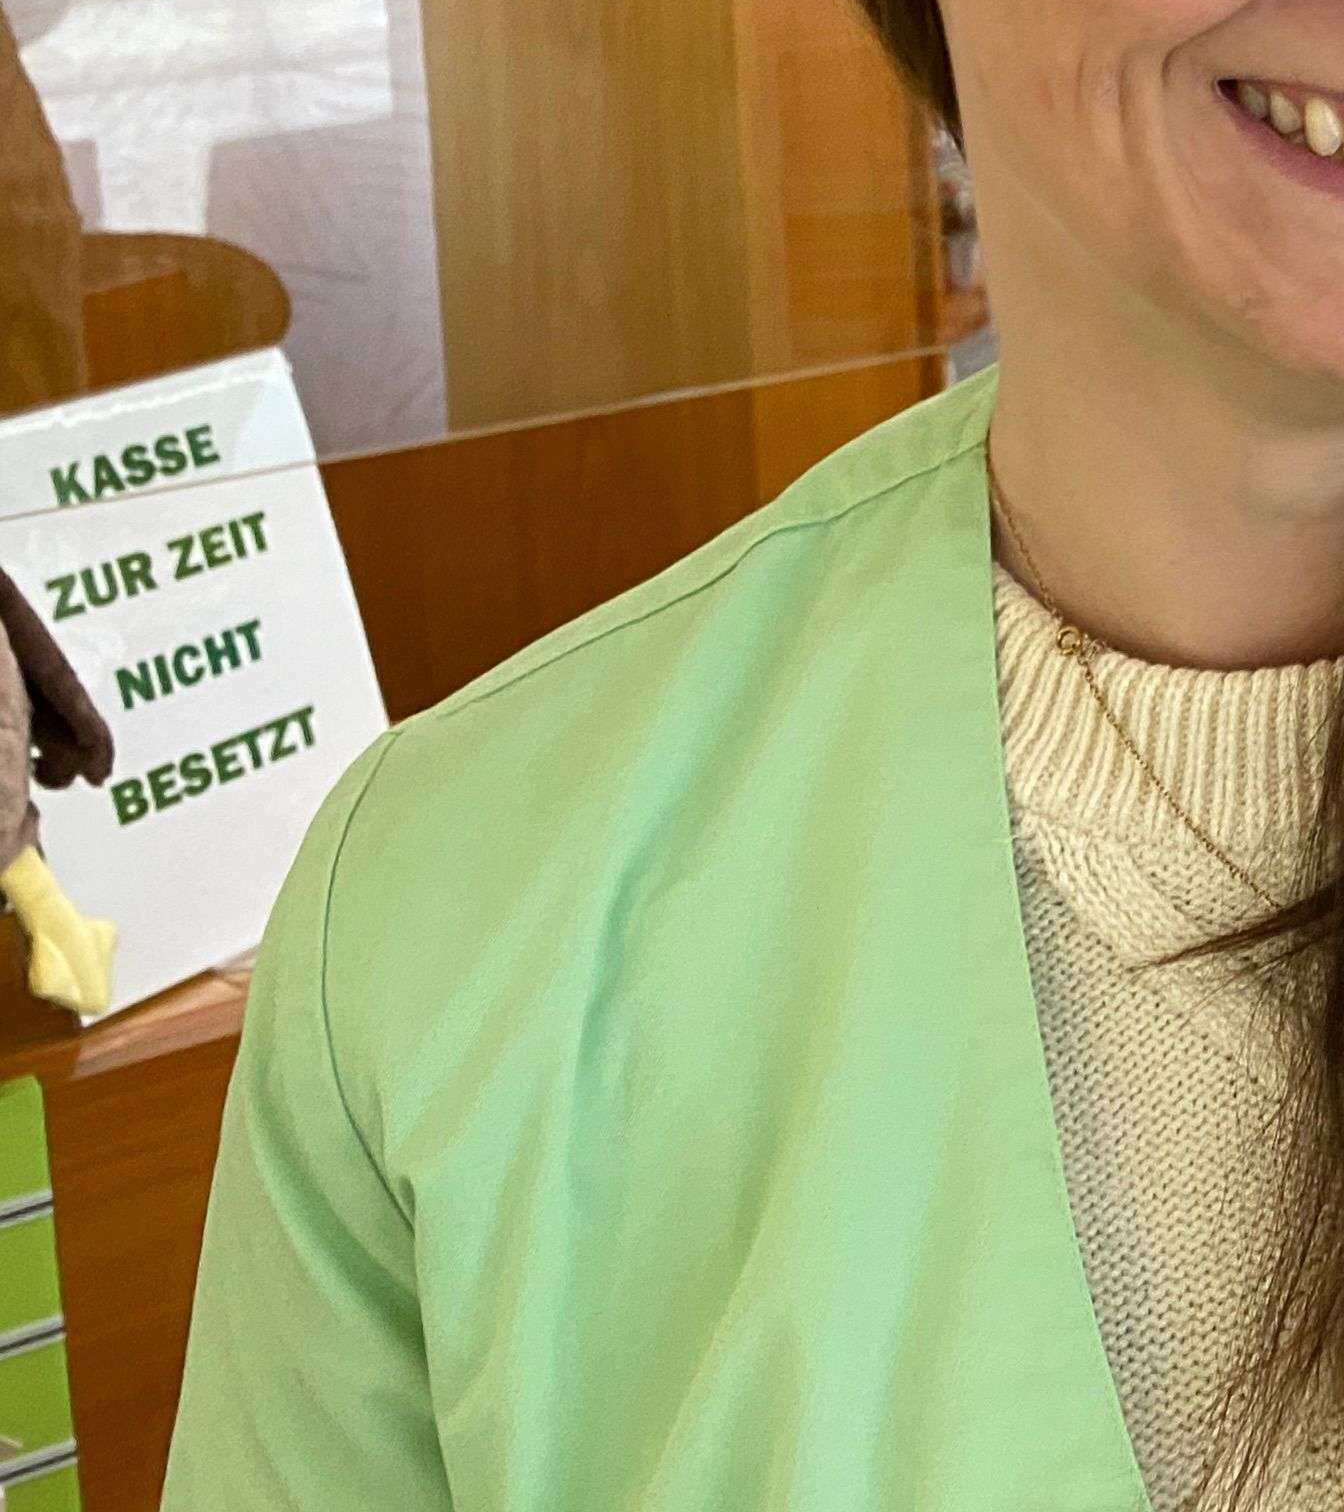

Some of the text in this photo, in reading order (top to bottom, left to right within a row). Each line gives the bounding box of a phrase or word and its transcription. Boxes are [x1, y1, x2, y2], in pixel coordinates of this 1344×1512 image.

[49, 424, 220, 506] KASSE
[45, 511, 269, 622] ZUR ZEIT
[115, 619, 262, 710] NICHT
[110, 705, 316, 826] BESETZT
